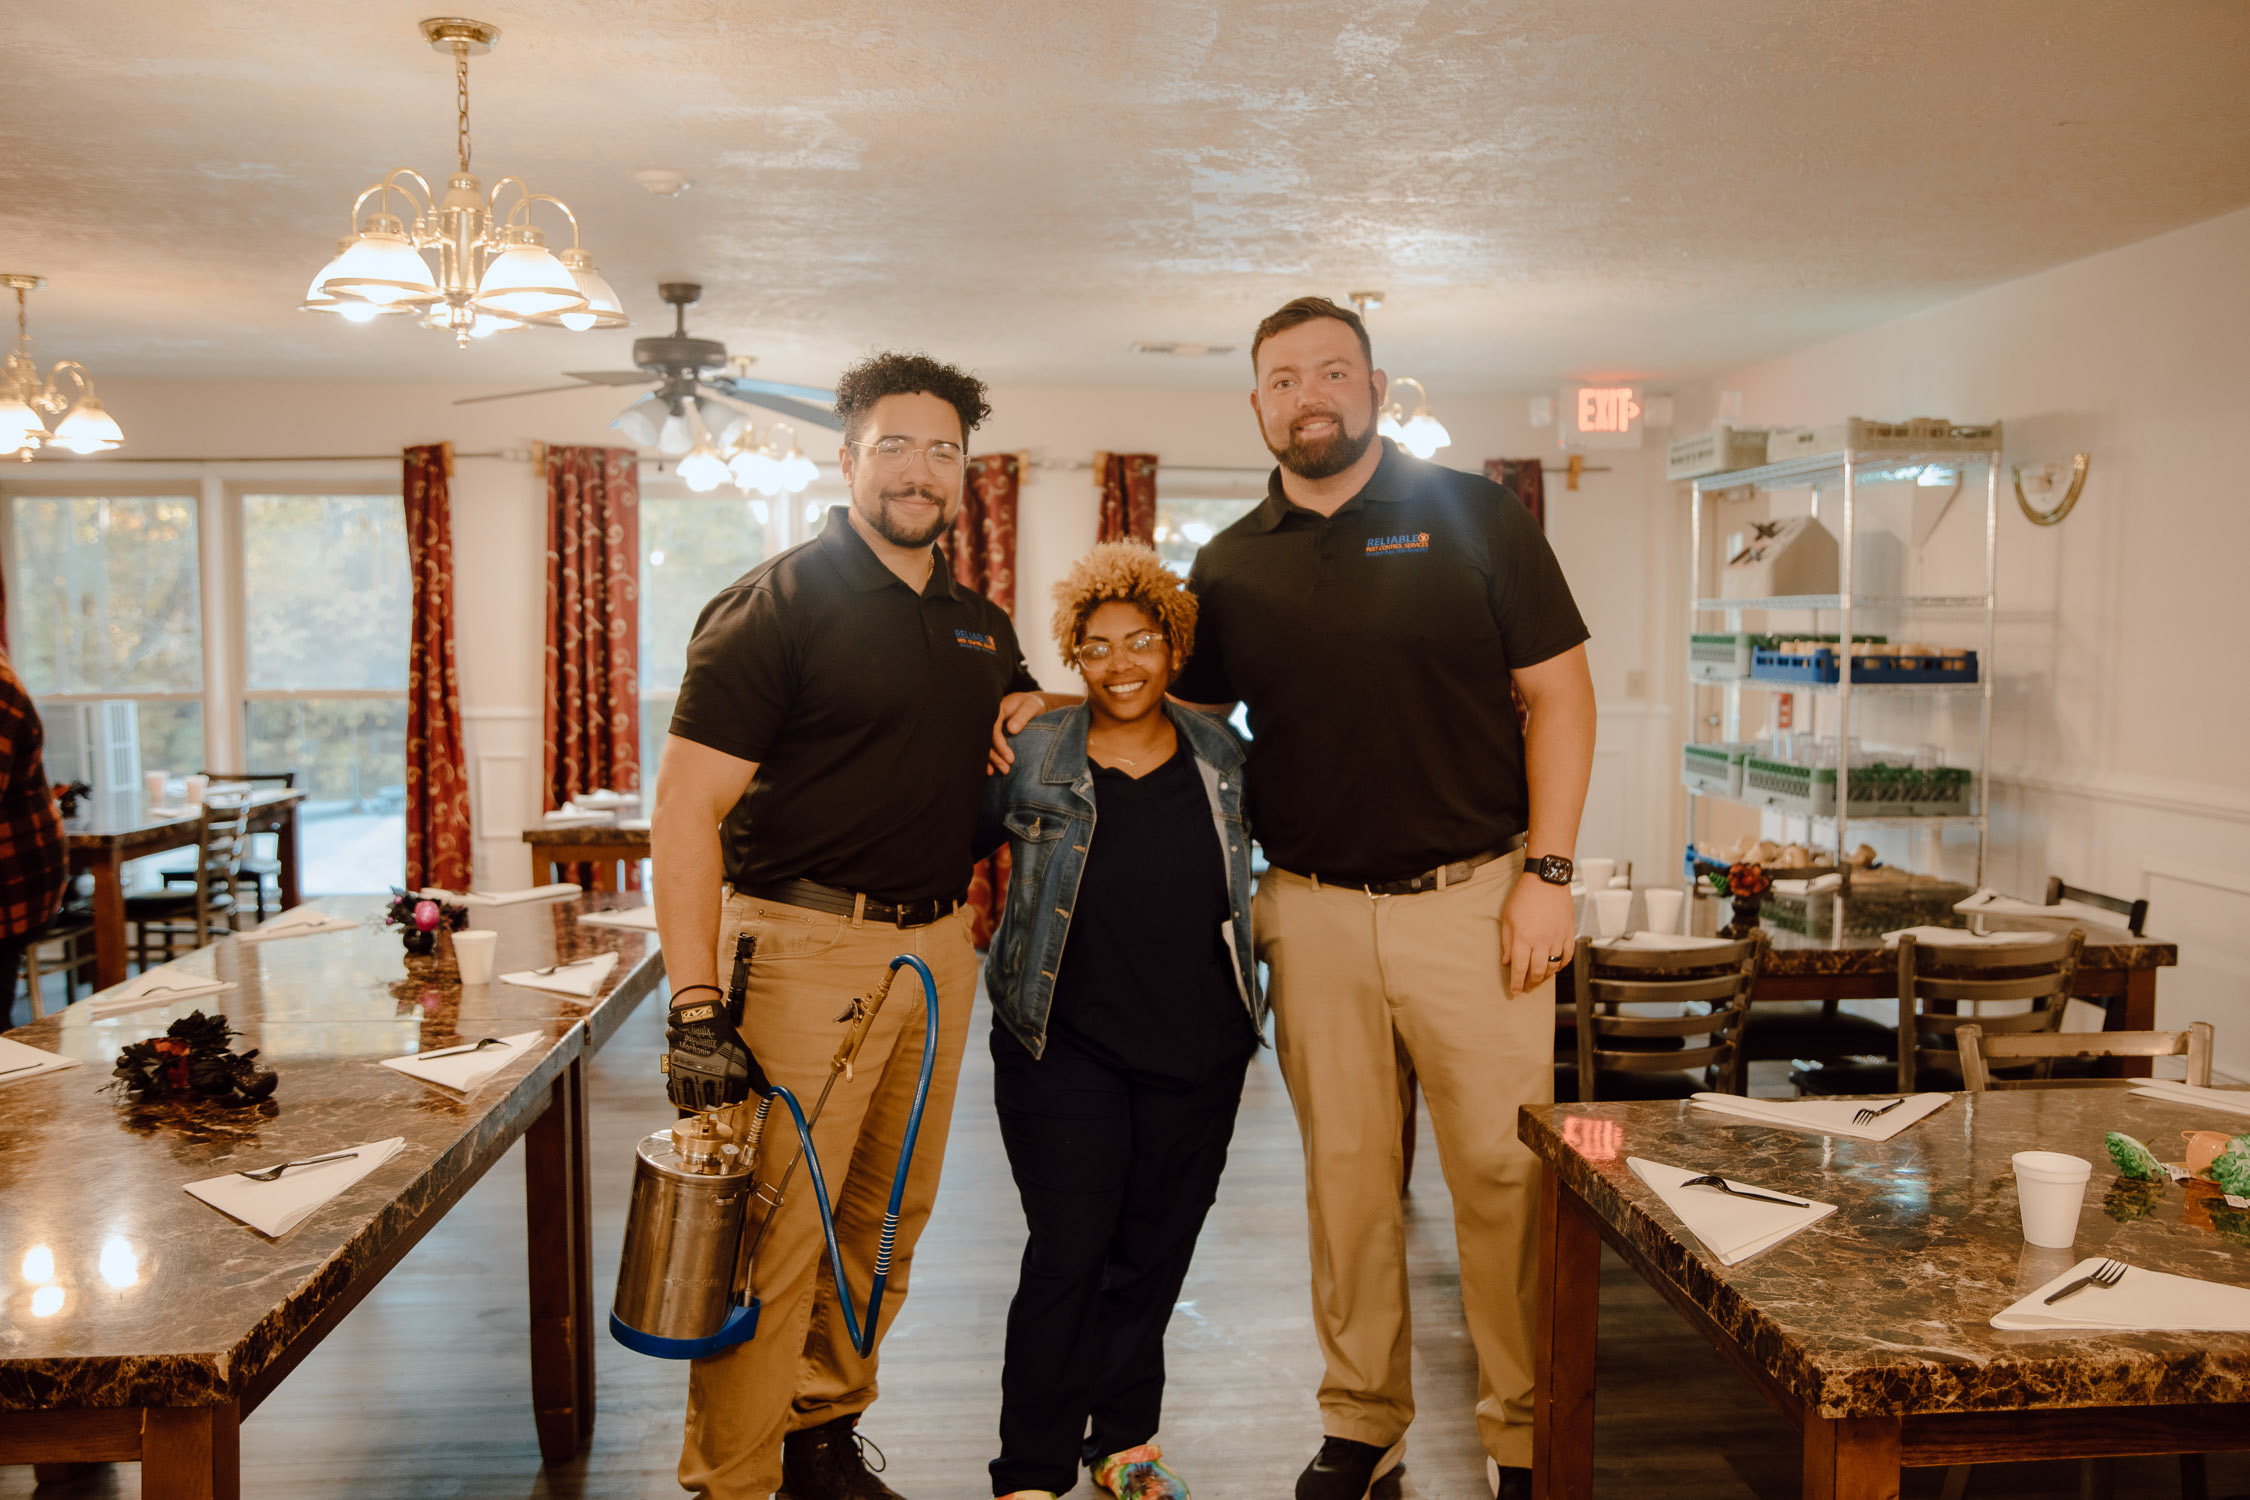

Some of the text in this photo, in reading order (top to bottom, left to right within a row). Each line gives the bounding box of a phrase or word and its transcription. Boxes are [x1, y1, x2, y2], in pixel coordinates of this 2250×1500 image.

[1577, 387, 1633, 433] EXIT
[1367, 534, 1418, 547] RELIABLE
[1379, 543, 1403, 551] CONTROL
